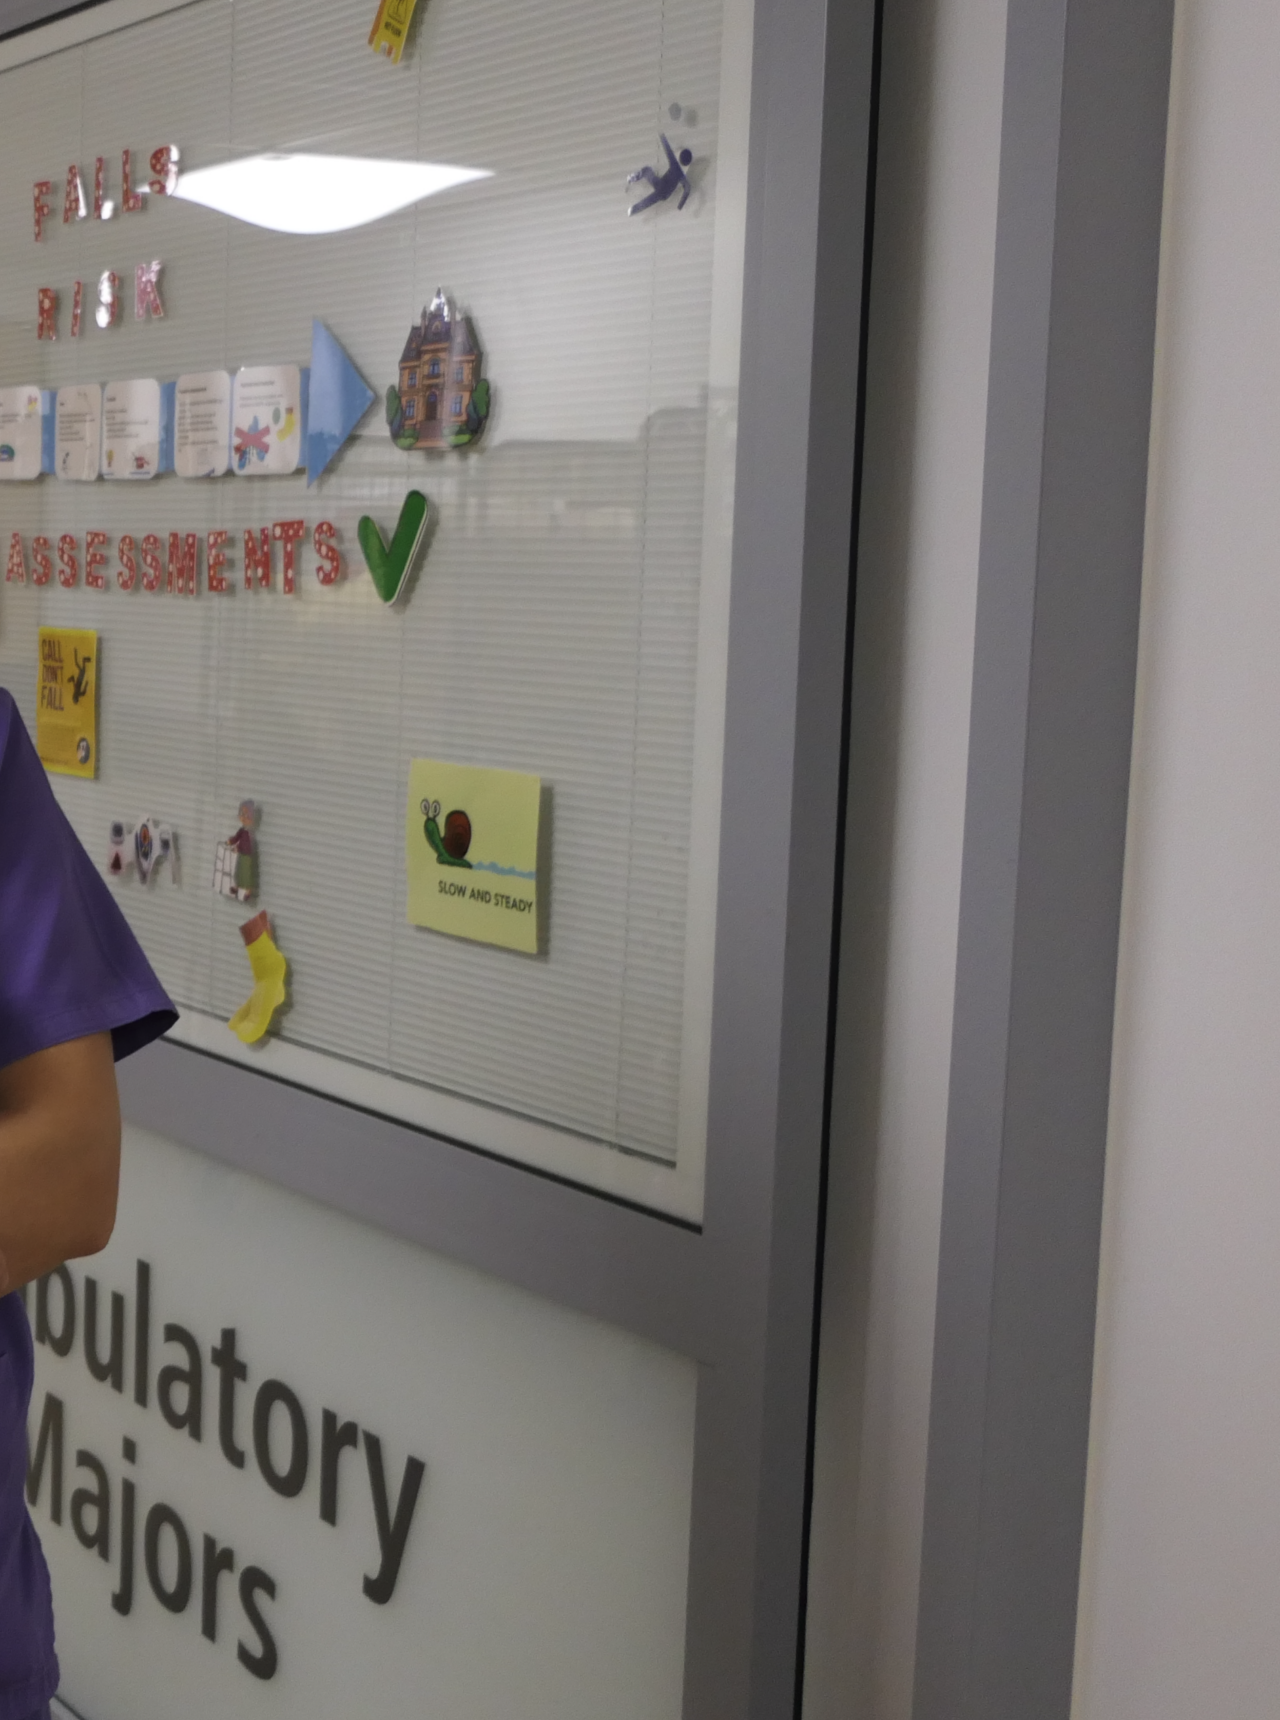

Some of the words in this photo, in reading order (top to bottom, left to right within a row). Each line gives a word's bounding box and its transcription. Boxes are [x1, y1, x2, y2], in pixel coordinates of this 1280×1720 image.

[34, 144, 181, 242] FALLS
[37, 260, 164, 341] RISK
[5, 520, 341, 596] ASSESSMENTS
[41, 639, 63, 663] CALL
[40, 685, 64, 711] FALL
[438, 880, 467, 898] SLOW
[469, 887, 492, 904] AND
[494, 893, 533, 914] STEADY
[21, 1259, 426, 1606] bulatory
